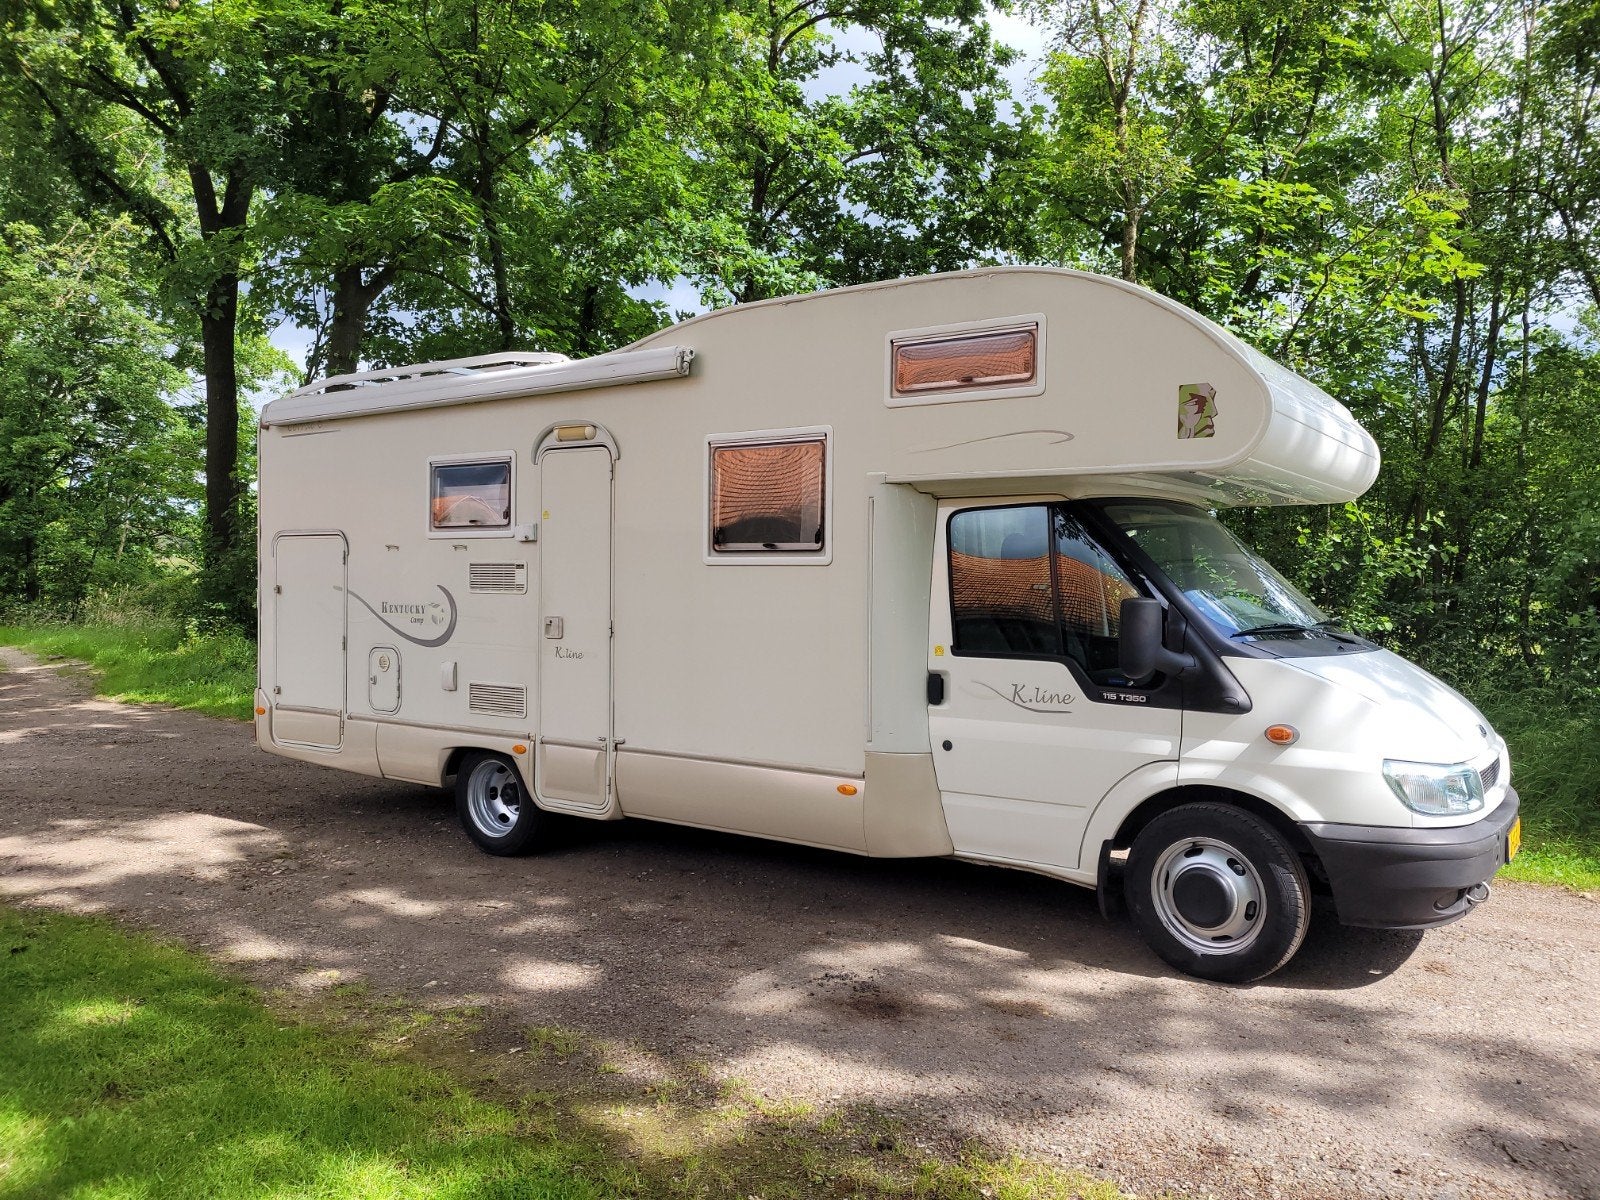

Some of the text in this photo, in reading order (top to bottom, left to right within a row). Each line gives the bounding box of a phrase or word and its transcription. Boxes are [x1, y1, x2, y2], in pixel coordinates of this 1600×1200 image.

[381, 601, 426, 615] KENTUCKY
[555, 646, 584, 660] K.line
[1011, 683, 1075, 705] K.line
[1102, 692, 1147, 703] 115 T350
